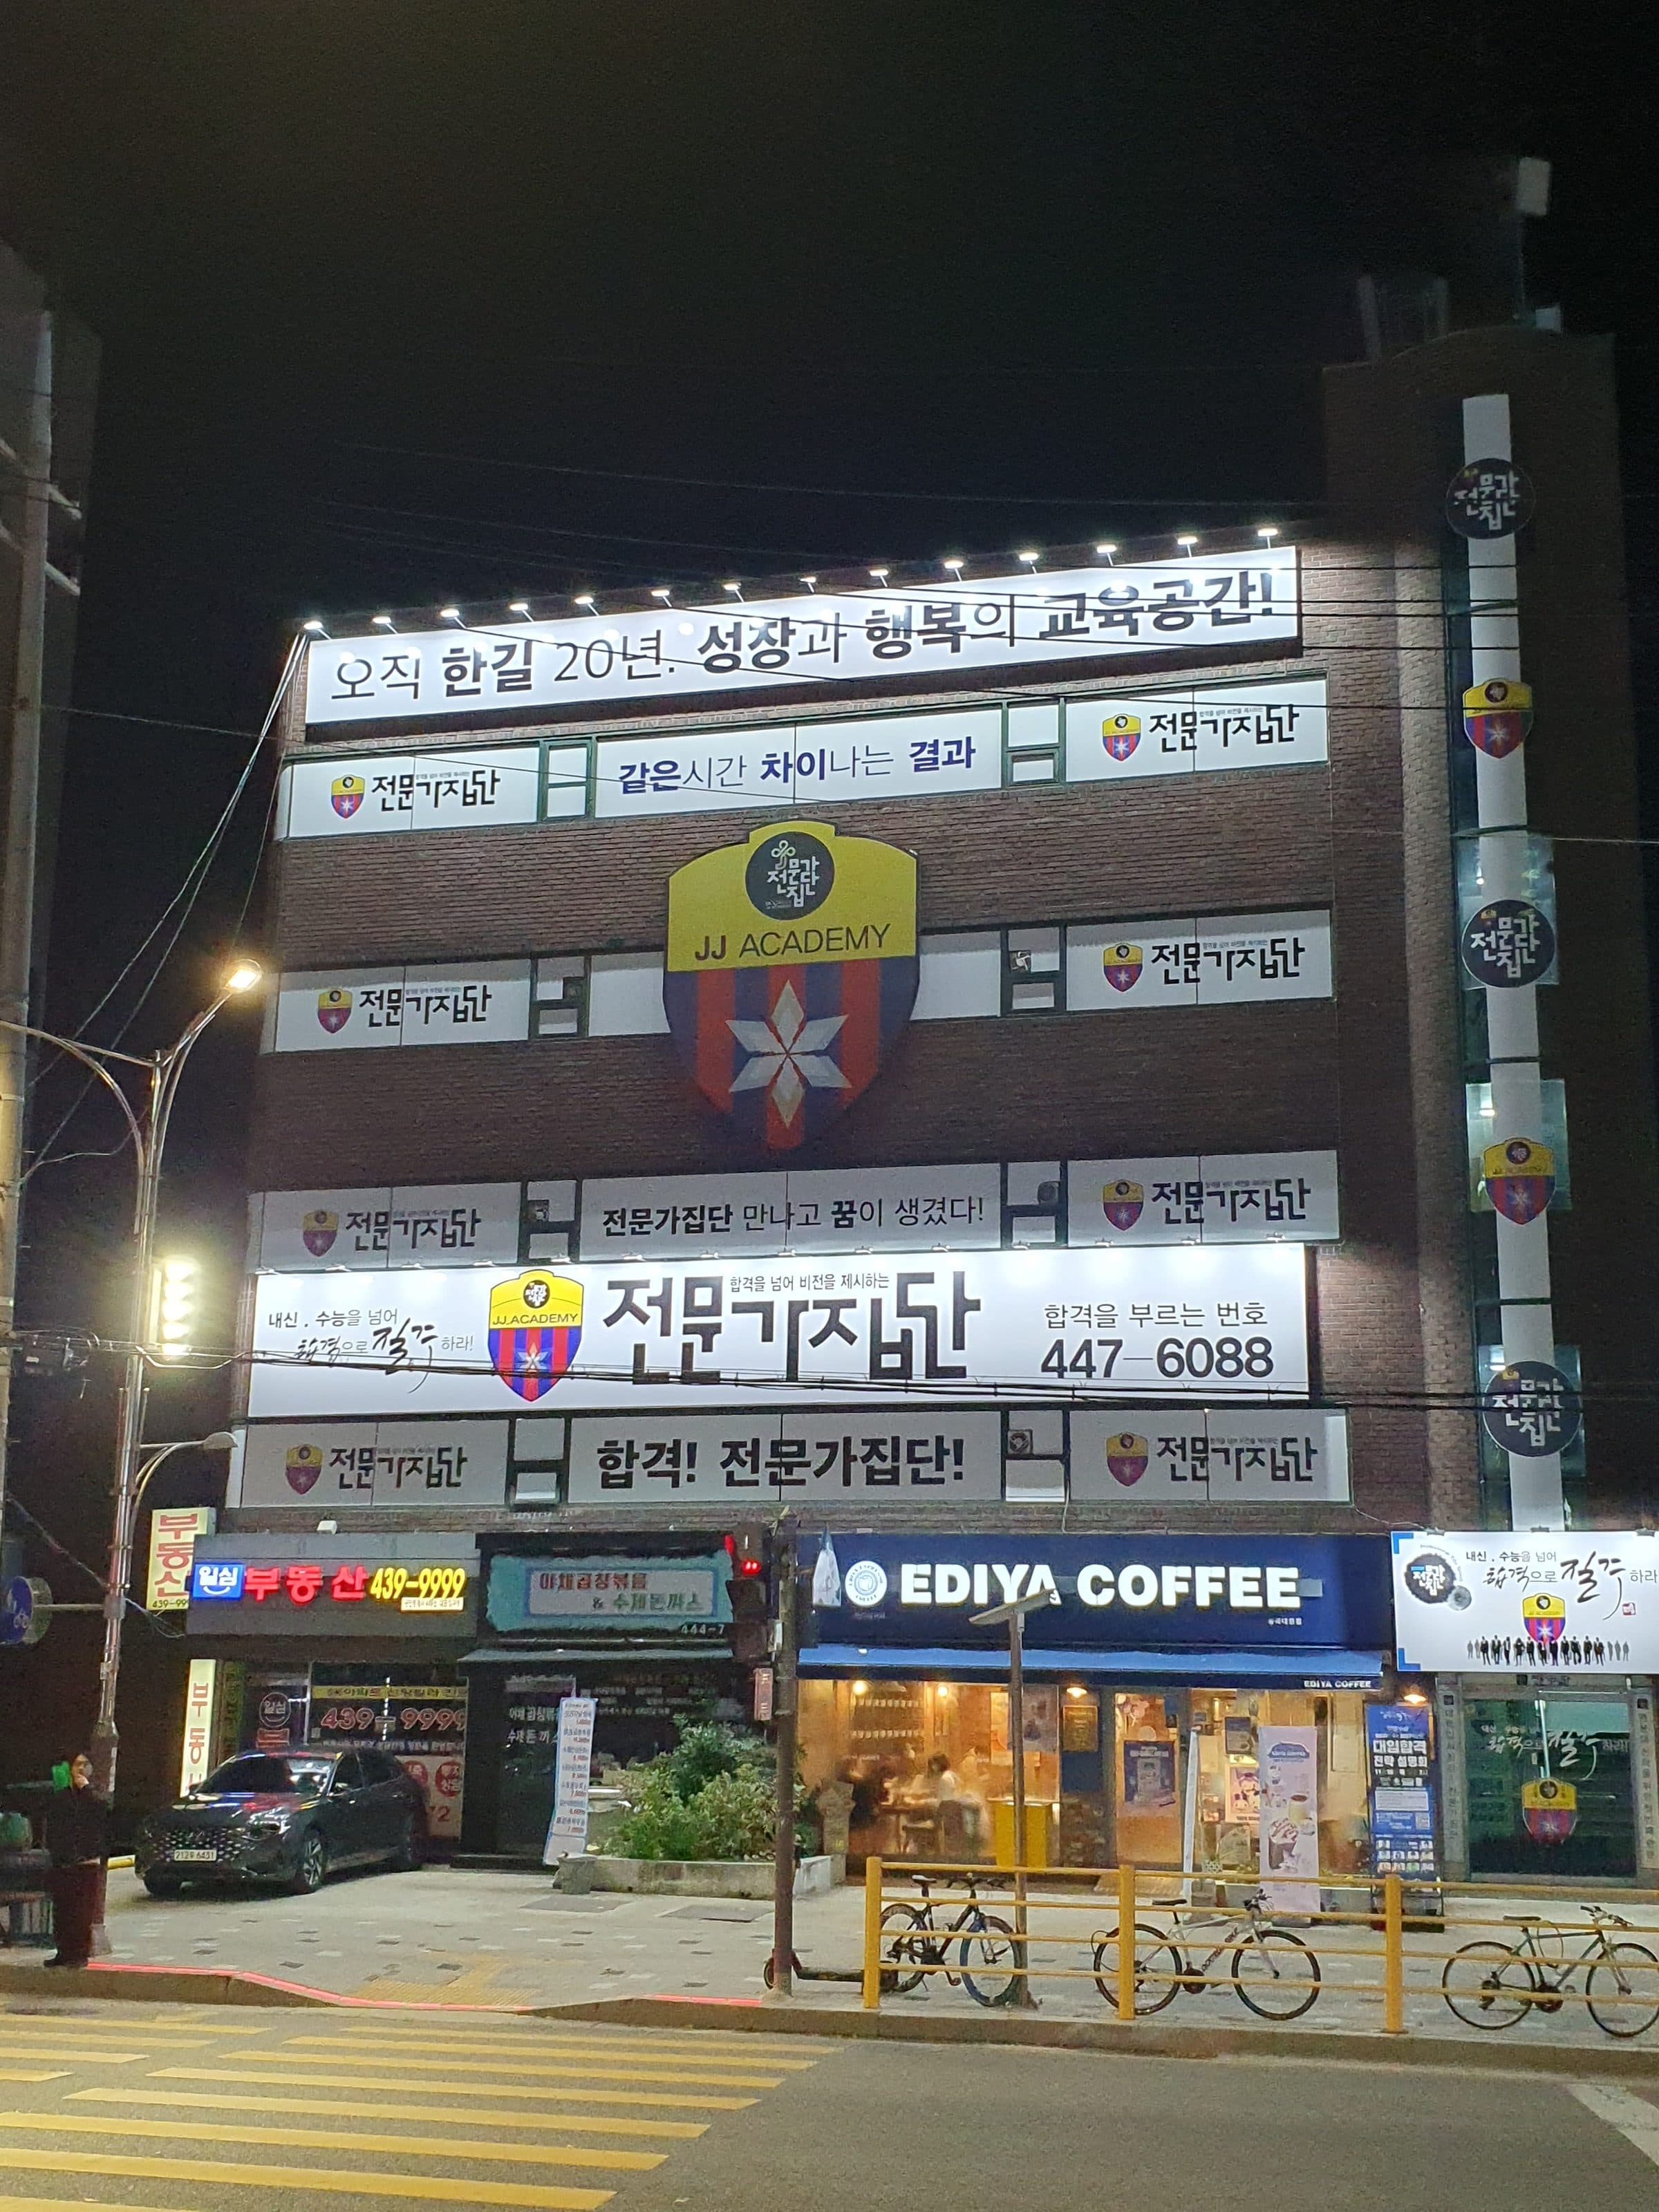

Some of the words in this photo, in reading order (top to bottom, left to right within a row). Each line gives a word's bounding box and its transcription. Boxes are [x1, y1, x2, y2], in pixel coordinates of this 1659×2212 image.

[332, 655, 419, 699] 오직
[442, 640, 533, 697] 한길
[554, 630, 674, 682] 20년.
[697, 612, 847, 673] 성장과
[865, 594, 1014, 659] 행복의
[1039, 571, 1273, 640] 교육공간!
[1149, 704, 1300, 753] 전문가집단
[910, 735, 975, 772] 결과
[372, 769, 500, 812] 전문가집단
[695, 935, 727, 961] JJ
[739, 923, 891, 958] ACADEMY
[1152, 937, 1305, 984] 전문가집단
[359, 985, 491, 1028] 전문가집단
[602, 1204, 733, 1237] 전문가집단
[744, 1200, 821, 1231] 만나고
[831, 1198, 883, 1229] 꿈이
[894, 1197, 983, 1226] 생겼다!
[1152, 1178, 1311, 1224] 전문가집단
[346, 1209, 481, 1251] 전문가집단
[730, 1275, 765, 1293] 합격을
[771, 1275, 794, 1291] 넘어
[800, 1274, 836, 1291] 비전을
[841, 1273, 890, 1289] 제시하는
[315, 1310, 362, 1327] 수능을
[368, 1308, 397, 1326] 넘어
[510, 1313, 579, 1324] ACADEMY
[603, 1271, 980, 1383] 전문가집단
[1044, 1303, 1118, 1329] 합격을
[1129, 1302, 1206, 1328] 부르는
[1217, 1301, 1268, 1327] 번호
[1040, 1336, 1273, 1378] 447-6088
[330, 1447, 467, 1489] 전문가집단
[597, 1439, 697, 1490] 합격!
[720, 1435, 964, 1486] 전문가집단!
[1156, 1436, 1318, 1481] 전문가집단
[198, 1566, 239, 1587] 일심
[244, 1564, 369, 1606] 부동산
[370, 1567, 466, 1600] 439-9999
[901, 1563, 1063, 1606] EDIYA
[1077, 1563, 1301, 1609] COFFEE
